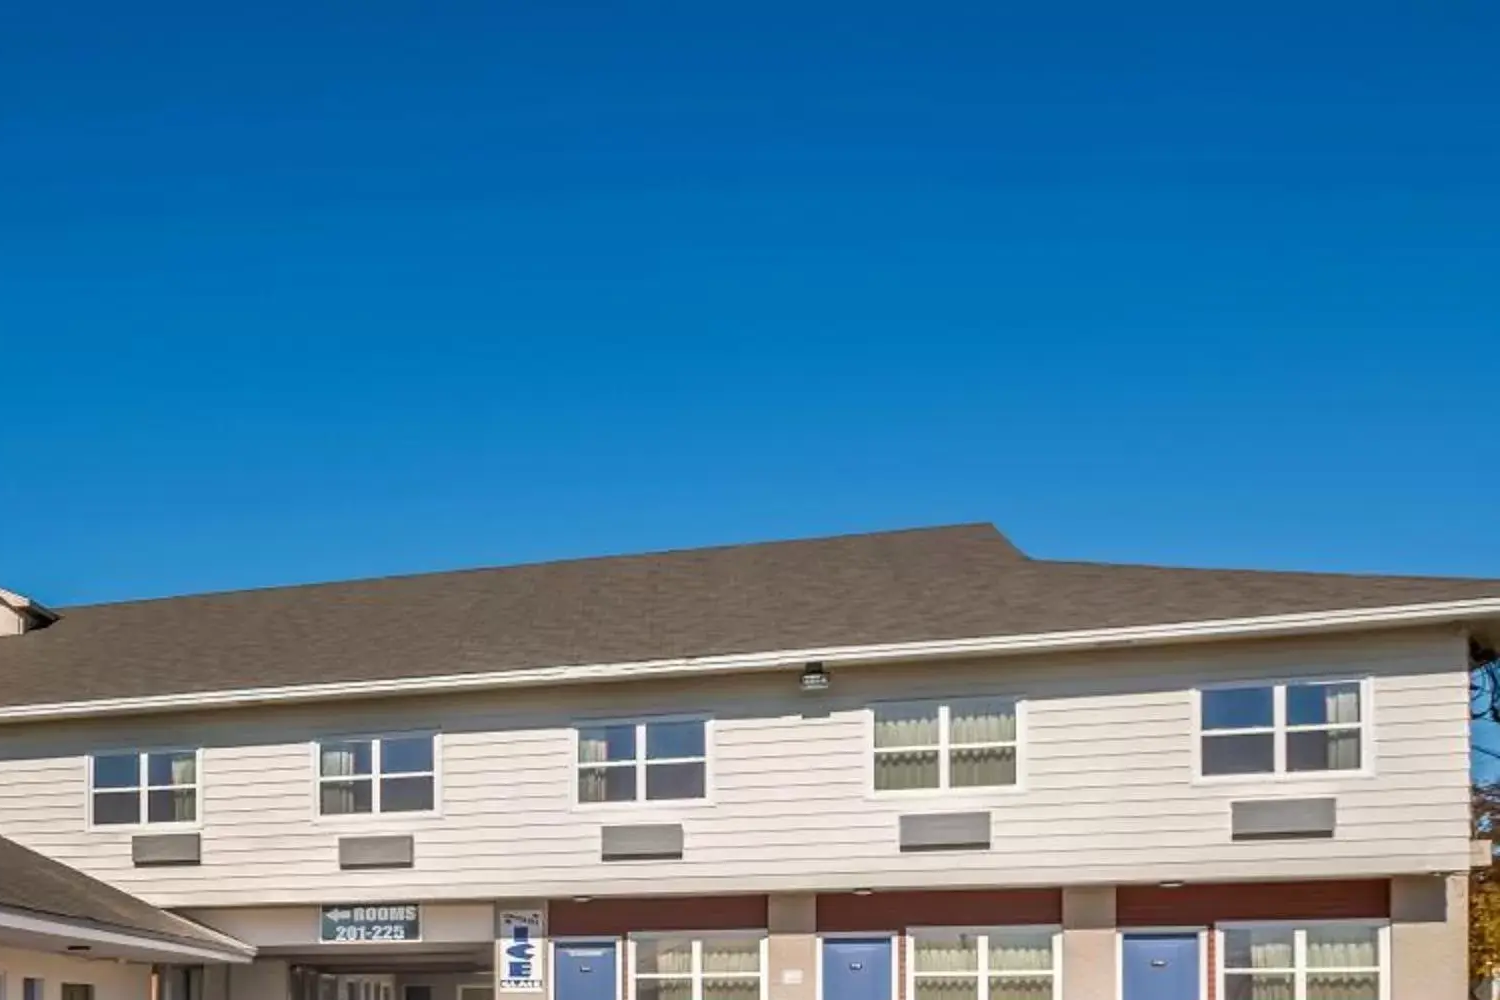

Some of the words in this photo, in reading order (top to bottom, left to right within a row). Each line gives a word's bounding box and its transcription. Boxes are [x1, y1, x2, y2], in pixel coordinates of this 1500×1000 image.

[353, 905, 417, 921] ROOMS
[336, 925, 405, 941] 201-225
[506, 926, 536, 978] ICE
